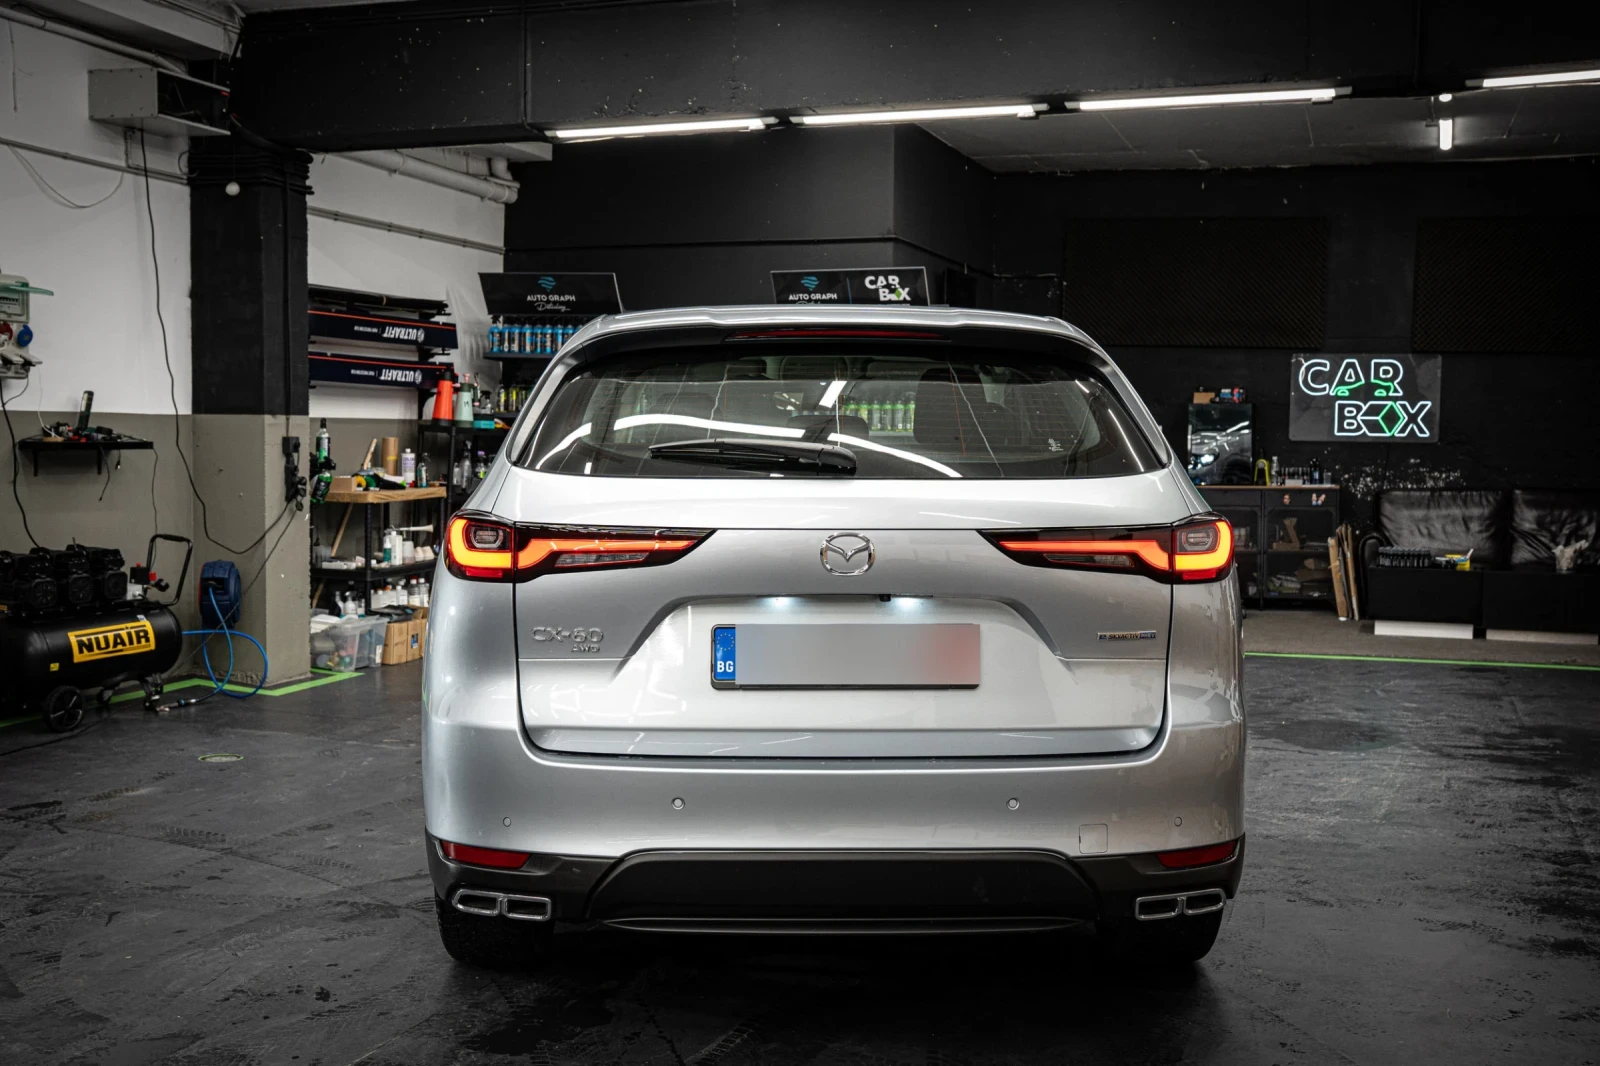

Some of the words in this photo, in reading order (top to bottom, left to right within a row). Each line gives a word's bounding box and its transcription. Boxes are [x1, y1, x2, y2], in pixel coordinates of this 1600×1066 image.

[864, 275, 900, 289] CAR
[878, 287, 911, 301] BOX
[382, 326, 417, 340] ULTRAFIT
[379, 368, 414, 382] ULTRAFIT
[1299, 359, 1403, 396] CAR
[1334, 401, 1432, 437] BOX
[76, 628, 150, 655] NUAIR
[532, 627, 604, 642] CX-60
[571, 644, 600, 652] AWD
[717, 661, 734, 673] BG
